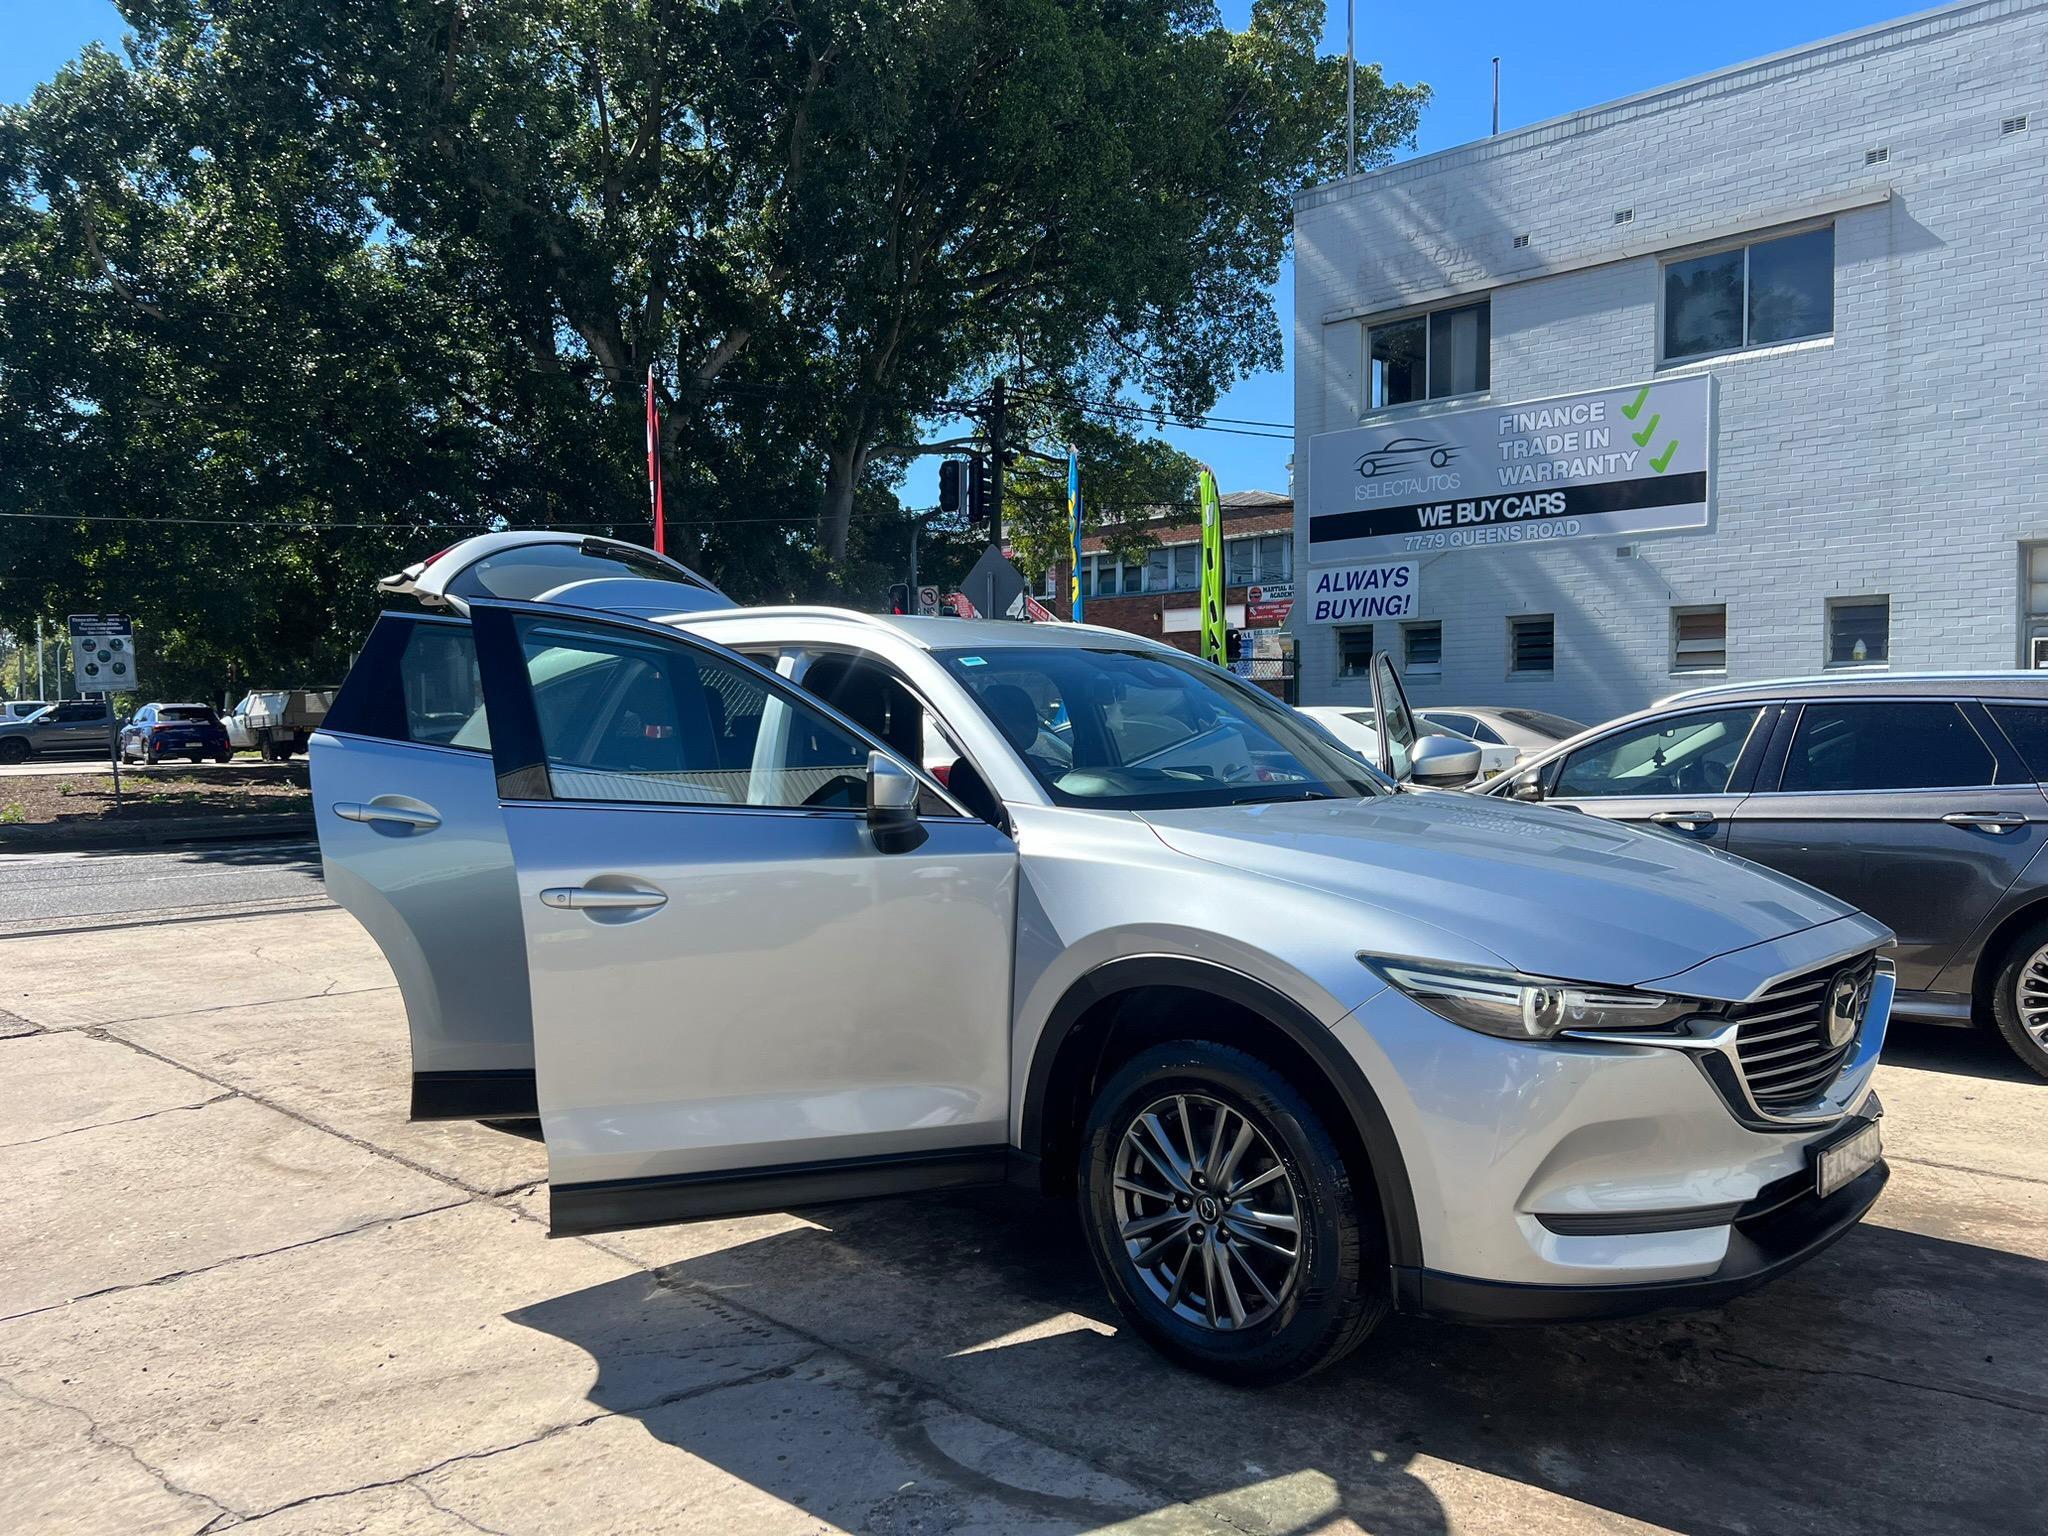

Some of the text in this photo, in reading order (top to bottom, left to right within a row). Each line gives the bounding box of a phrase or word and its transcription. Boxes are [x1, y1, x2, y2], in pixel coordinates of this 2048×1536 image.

[1498, 401, 1606, 435] FINANCE
[1498, 427, 1610, 461] TRADE IN
[1497, 450, 1639, 486] WARRANTY
[1417, 492, 1566, 528] WE BUY CARS
[1404, 520, 1581, 552] 77-79 QUEENS ROAD
[1316, 566, 1410, 594] ALWAYS
[1314, 594, 1411, 620] BUYING!
